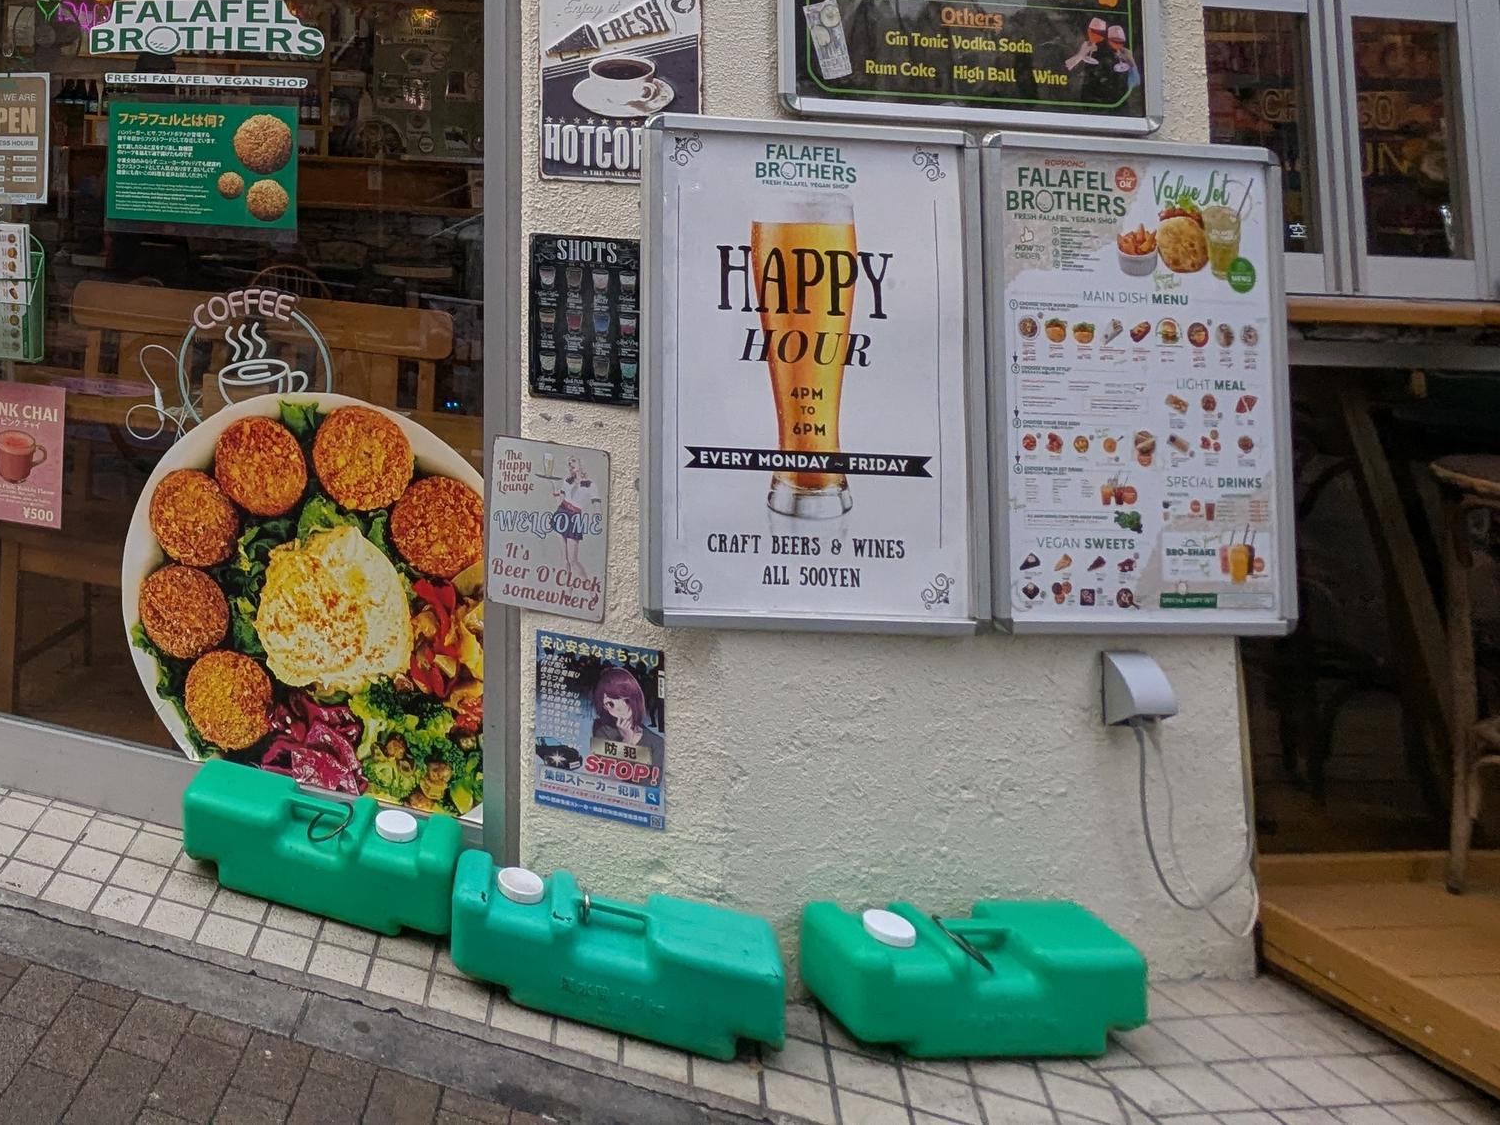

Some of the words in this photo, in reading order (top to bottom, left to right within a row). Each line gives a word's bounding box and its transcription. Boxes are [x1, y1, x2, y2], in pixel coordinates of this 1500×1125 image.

[114, 0, 298, 25] FALAFEL
[941, 7, 1003, 26] Others
[91, 25, 324, 56] BROTHERS
[885, 31, 908, 47] Gin
[911, 32, 948, 49] Tonic
[951, 35, 996, 52] Vodka
[999, 38, 1033, 54] Soda
[106, 74, 147, 83] FRESH
[152, 75, 209, 84] FALAFEL
[214, 76, 263, 85] VEGAN
[268, 78, 307, 87] SHOP
[865, 59, 897, 75] Rum
[900, 61, 937, 78] Coke
[953, 65, 985, 83] High
[988, 68, 1017, 83] Ball
[1032, 70, 1068, 86] Wine
[765, 143, 847, 165] FALAFEL
[755, 160, 857, 184] BROTHERS
[1017, 166, 1113, 193] FALAFEL
[1006, 189, 1127, 217] BROTHERS
[557, 239, 617, 263] SHOTS
[716, 245, 893, 319] HAPPY
[192, 288, 297, 331] COFFEE
[1083, 290, 1116, 303] MAIN
[1118, 292, 1148, 304] DISH
[1151, 293, 1189, 306] MENU
[739, 328, 871, 367] HOUR
[790, 386, 824, 401] 4PM
[1176, 378, 1211, 390] LIGHT
[1214, 379, 1246, 391] MEAL
[22, 405, 59, 423] CHAI
[800, 405, 816, 416] TO
[792, 422, 826, 437] 6PM
[497, 459, 532, 473] Happy
[505, 449, 522, 461] The
[700, 450, 752, 466] EVERY
[758, 453, 830, 470] MONDAY
[849, 457, 909, 473] FRIDAY
[496, 480, 534, 495] Lounge
[502, 472, 529, 482] Hour
[1166, 476, 1215, 488] SPECIAL
[1217, 477, 1262, 489] DRINKS
[23, 506, 54, 522] ¥500
[493, 510, 603, 539] WELCOME
[505, 542, 530, 561] It's
[707, 534, 762, 555] CRAFT
[771, 536, 821, 557] BEERS
[830, 538, 842, 556] &
[853, 538, 906, 559] WINES
[1036, 537, 1081, 549] VEGAN
[1084, 538, 1135, 550] SWEETS
[491, 557, 531, 580] Beer
[536, 565, 601, 593] O'Clock
[762, 564, 791, 586] ALL
[798, 566, 860, 589] 500YEN
[502, 582, 598, 611] somewhere
[584, 754, 660, 786] STOP!
